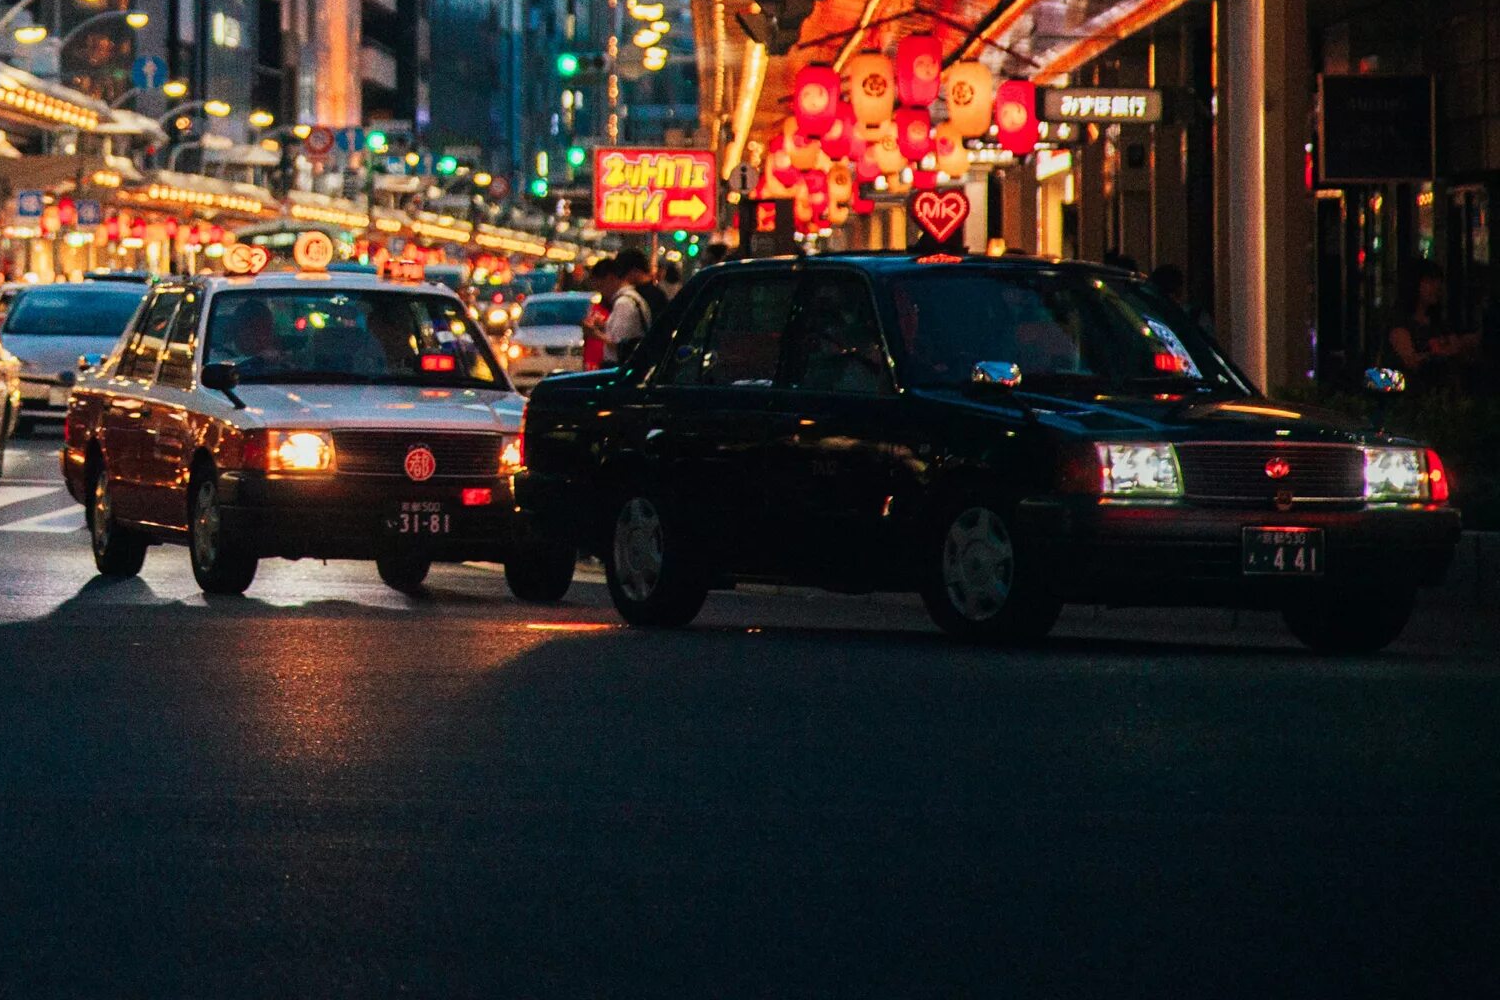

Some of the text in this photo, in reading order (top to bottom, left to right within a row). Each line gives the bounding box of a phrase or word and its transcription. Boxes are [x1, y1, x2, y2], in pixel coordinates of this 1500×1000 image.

[603, 154, 708, 188] ネットカフェ
[922, 202, 957, 219] MK
[399, 514, 450, 533] 31-81
